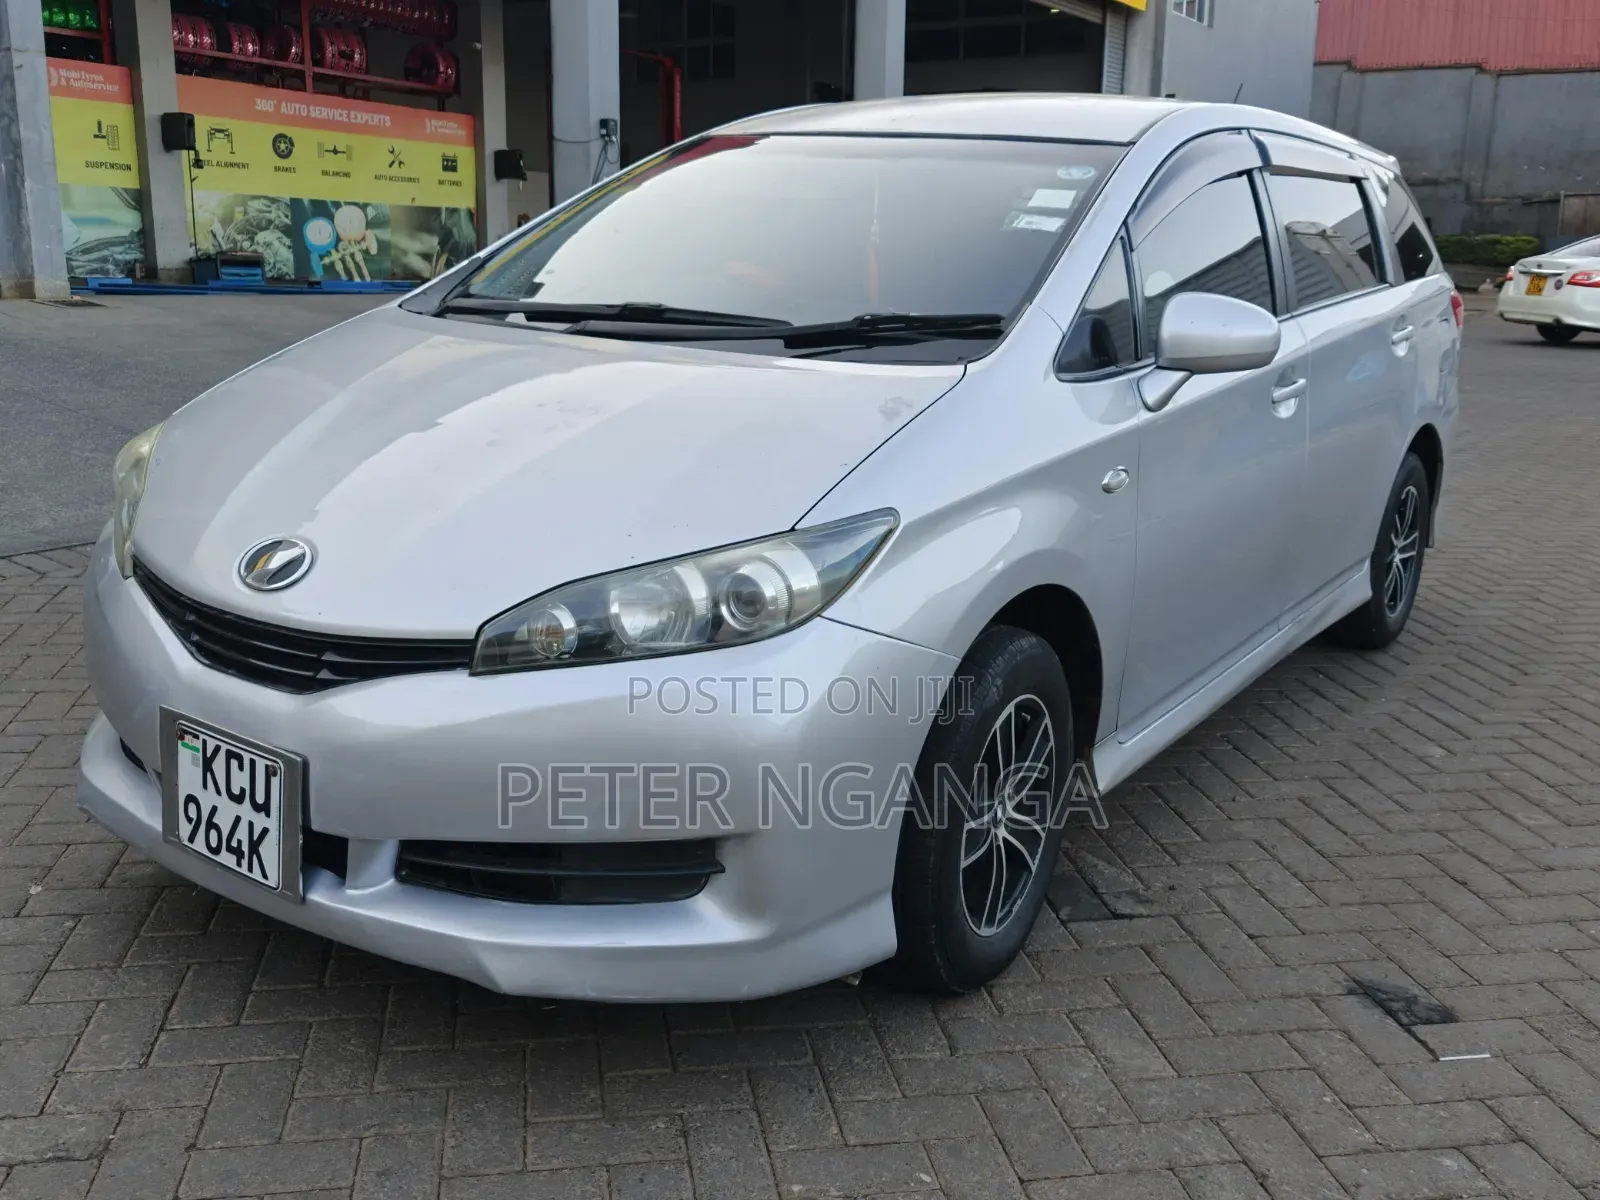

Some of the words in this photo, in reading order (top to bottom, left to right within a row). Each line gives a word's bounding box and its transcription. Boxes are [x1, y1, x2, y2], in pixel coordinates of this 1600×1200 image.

[60, 77, 67, 86] &
[69, 78, 119, 92] Autoservice
[281, 101, 308, 117] AUTO
[309, 105, 349, 121] SERVICE
[350, 110, 392, 127] EXPERTS
[84, 160, 132, 171] SUSPENSION
[216, 161, 250, 170] ALIGNMENT
[273, 165, 297, 174] BRAKES
[321, 169, 351, 179] BALANCING
[374, 174, 388, 182] AUTO
[388, 175, 421, 184] ACCESSORIES
[438, 179, 463, 188] BATTERIES
[202, 738, 272, 819] KCU
[183, 793, 270, 881] 964K
